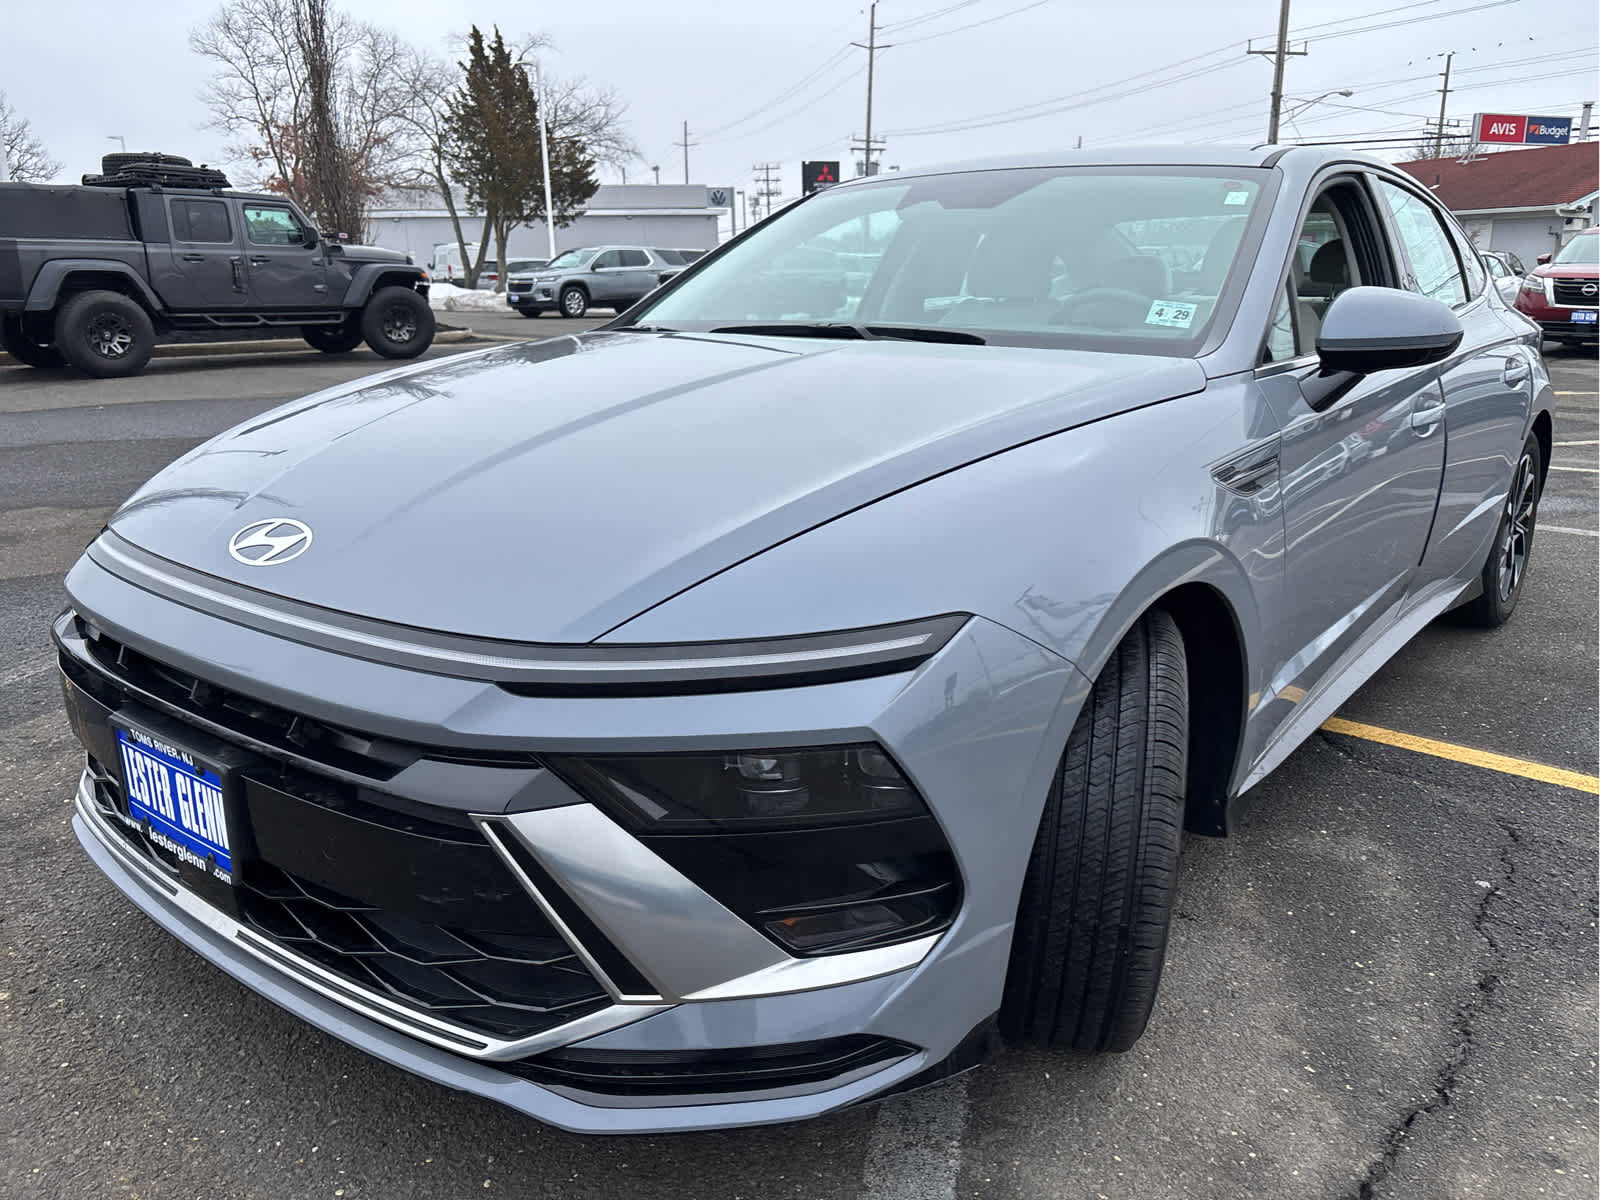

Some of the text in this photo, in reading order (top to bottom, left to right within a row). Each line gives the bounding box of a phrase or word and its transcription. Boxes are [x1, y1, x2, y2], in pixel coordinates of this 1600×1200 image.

[1489, 122, 1517, 136] AVIS
[1538, 124, 1569, 138] Budget
[1172, 309, 1190, 321] 29
[130, 728, 154, 748] TOMS
[181, 751, 194, 767] NJ
[121, 743, 230, 850] LESTER GLENN
[148, 825, 207, 872] lesterglenn
[213, 868, 232, 886] .com
